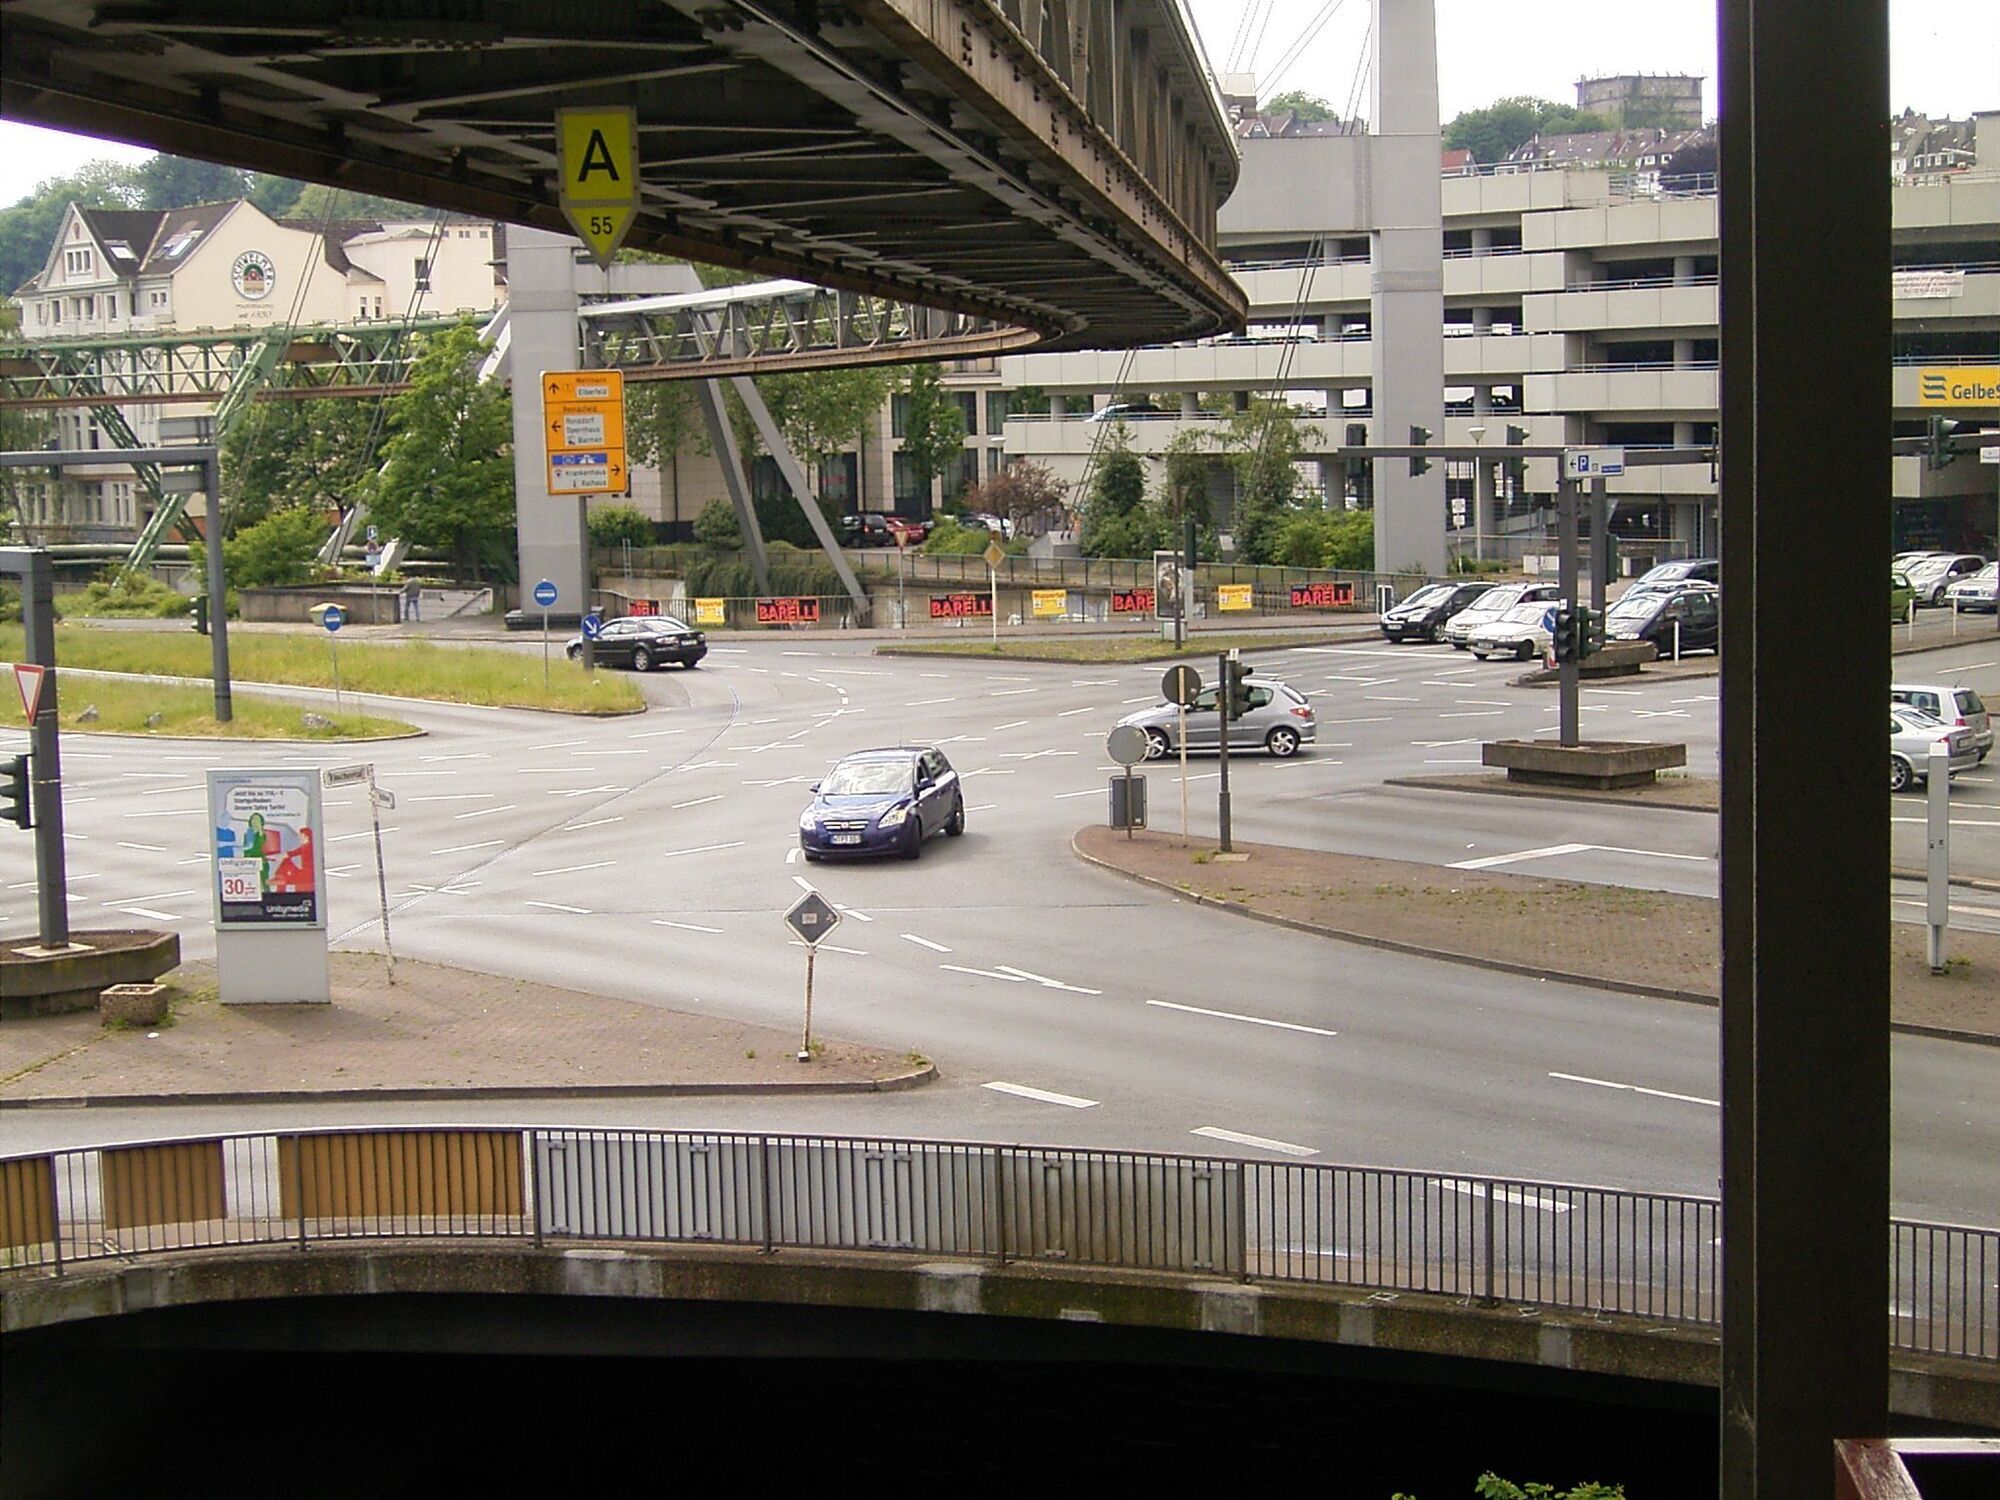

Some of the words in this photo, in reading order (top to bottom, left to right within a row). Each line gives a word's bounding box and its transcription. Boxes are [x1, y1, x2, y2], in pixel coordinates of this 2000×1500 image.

[578, 129, 620, 182] A
[590, 216, 613, 235] 55
[233, 252, 273, 281] SCHWELMER
[578, 387, 607, 396] Elberfeld
[566, 416, 595, 425] Ronsdorf
[566, 426, 601, 435] Opernhaus
[577, 435, 603, 444] Barmen
[565, 468, 607, 477] Krankenhaus
[581, 479, 607, 487] Rathaus
[1113, 595, 1155, 611] BARE
[1292, 590, 1352, 606] BARELLI
[758, 605, 817, 621] BARELLI
[224, 879, 244, 895] 30
